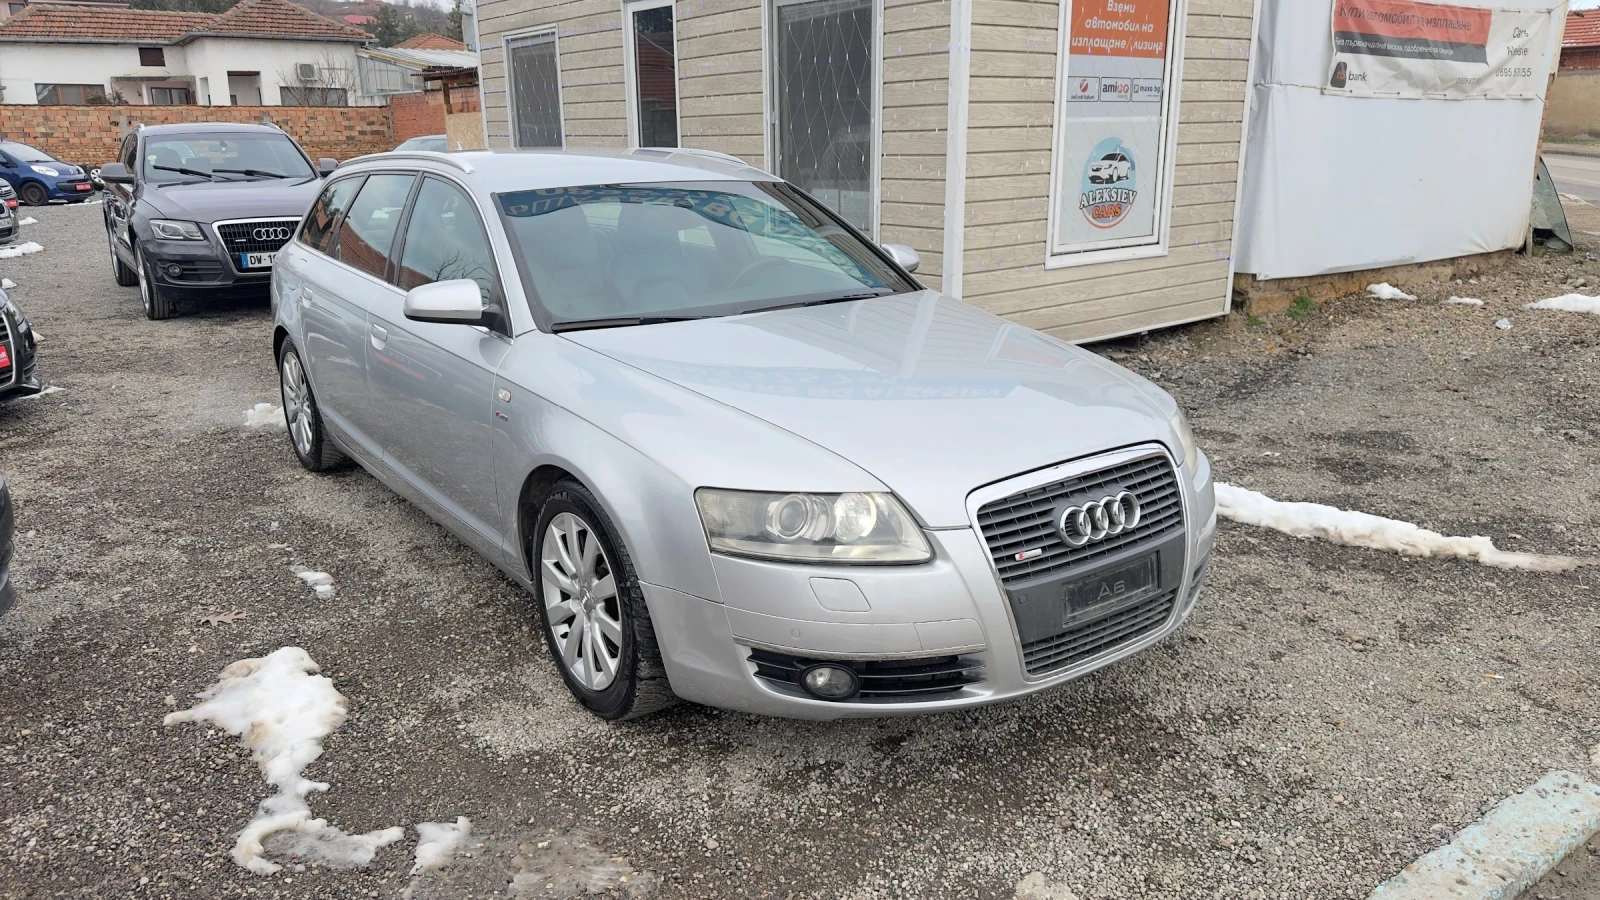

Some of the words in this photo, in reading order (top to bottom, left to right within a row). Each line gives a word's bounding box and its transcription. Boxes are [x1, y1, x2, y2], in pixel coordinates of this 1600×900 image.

[1107, 0, 1136, 13] Вземи
[1085, 16, 1140, 32] автомобил
[1142, 23, 1154, 33] на
[1072, 36, 1127, 49] изплащане
[1133, 42, 1163, 51] лизинг
[1348, 71, 1367, 81] bank
[1079, 187, 1137, 209] ALEKSIEV
[1092, 203, 1122, 219] CARS
[1096, 580, 1125, 601] A6
